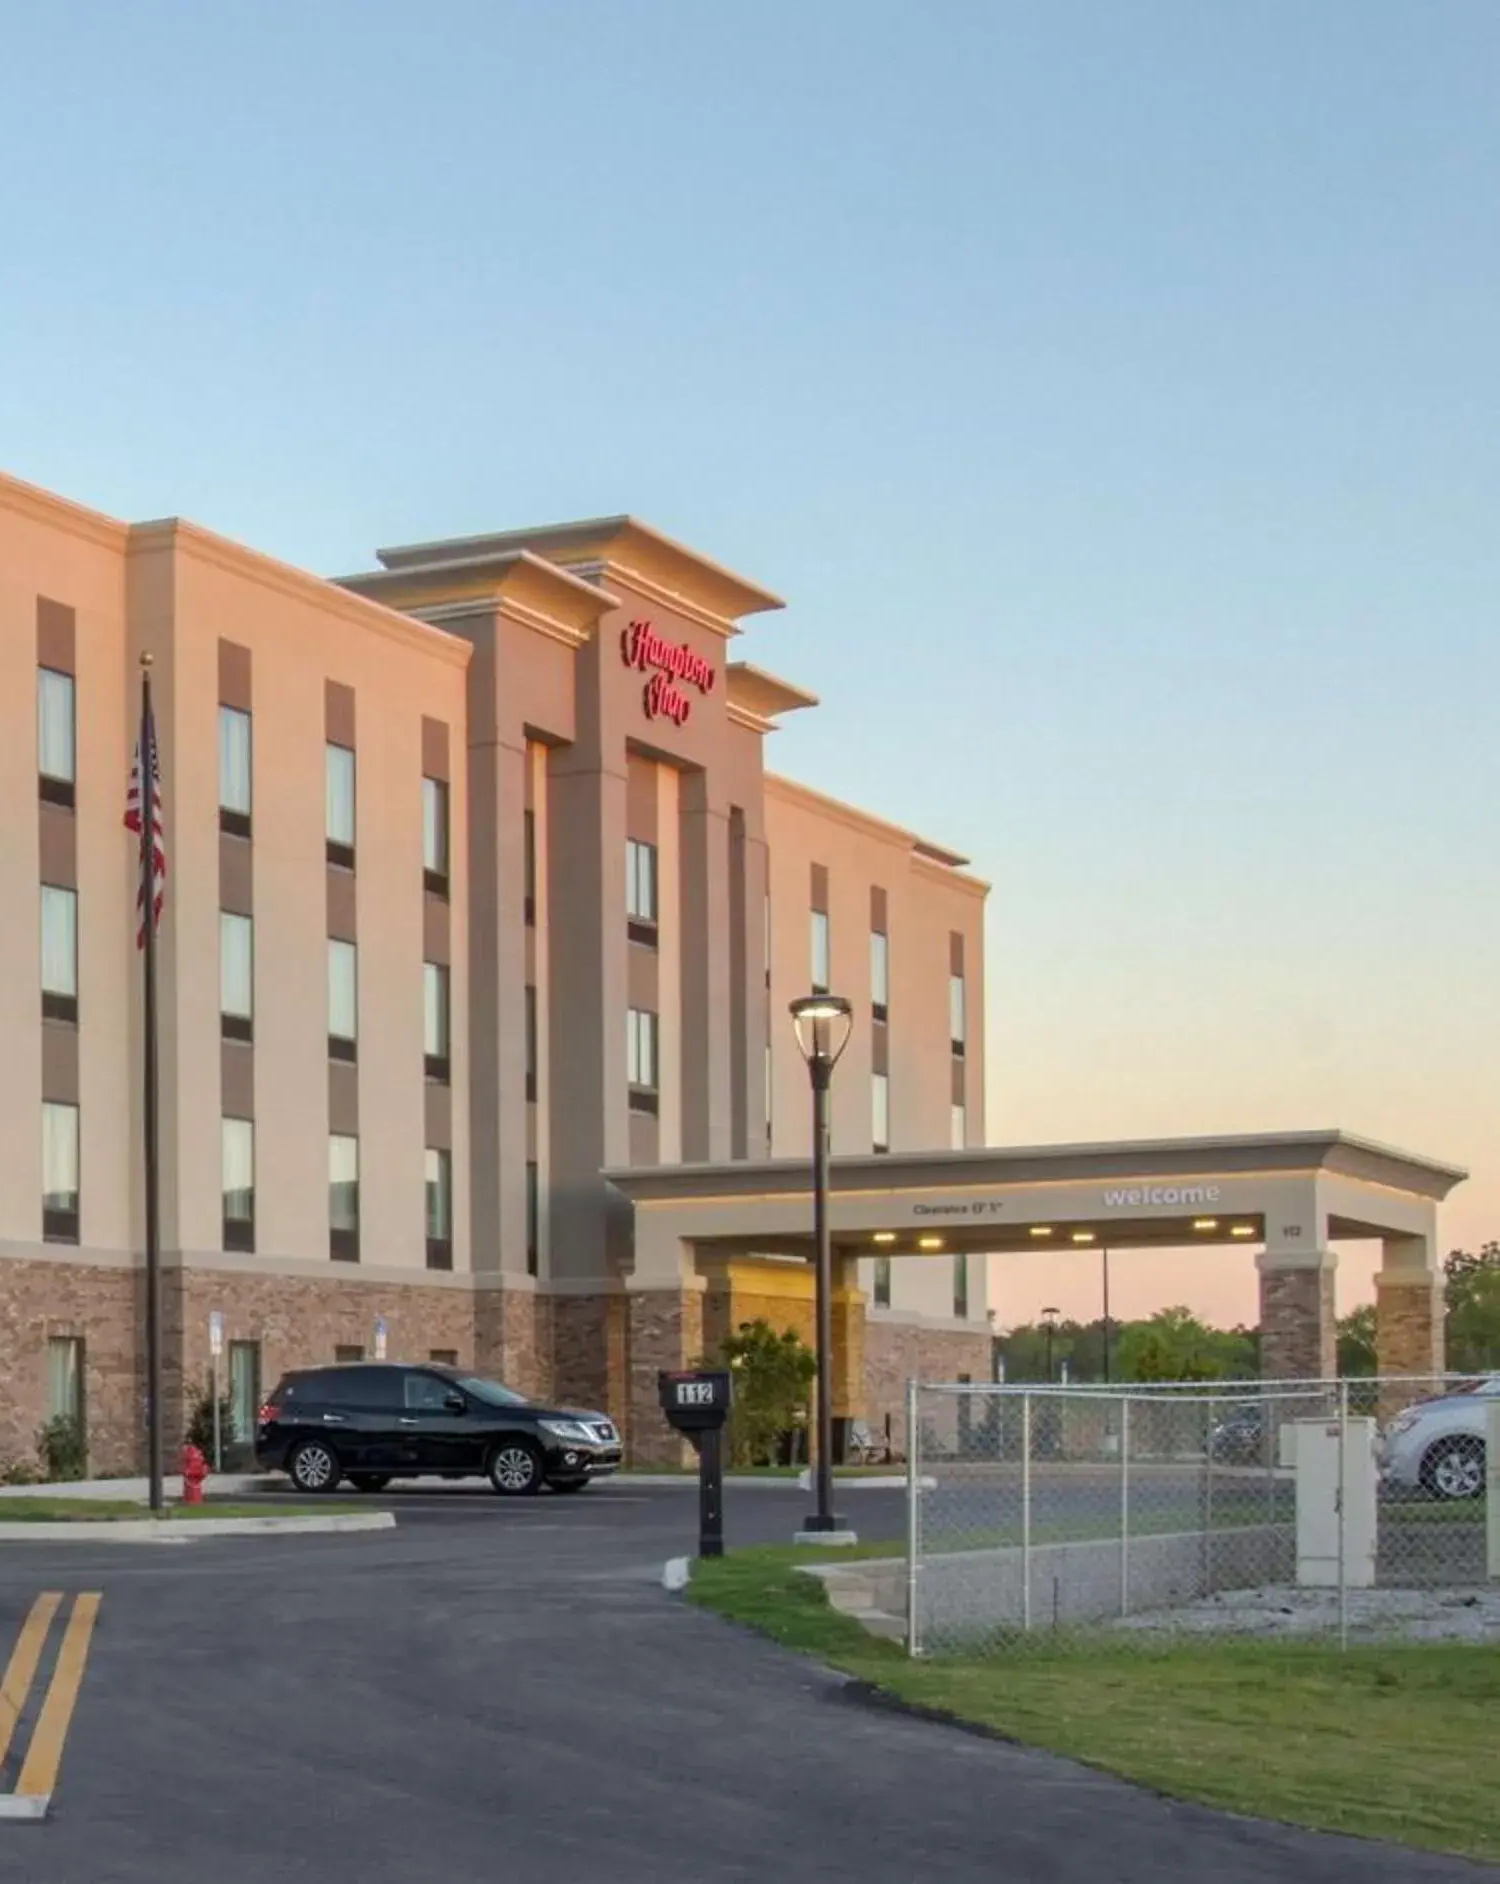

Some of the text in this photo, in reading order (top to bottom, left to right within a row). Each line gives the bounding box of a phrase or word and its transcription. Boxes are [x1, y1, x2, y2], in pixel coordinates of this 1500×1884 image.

[620, 617, 715, 695] Hampton
[643, 671, 690, 726] Inn
[1103, 1185, 1221, 1206] welcome
[677, 1382, 714, 1405] 112
